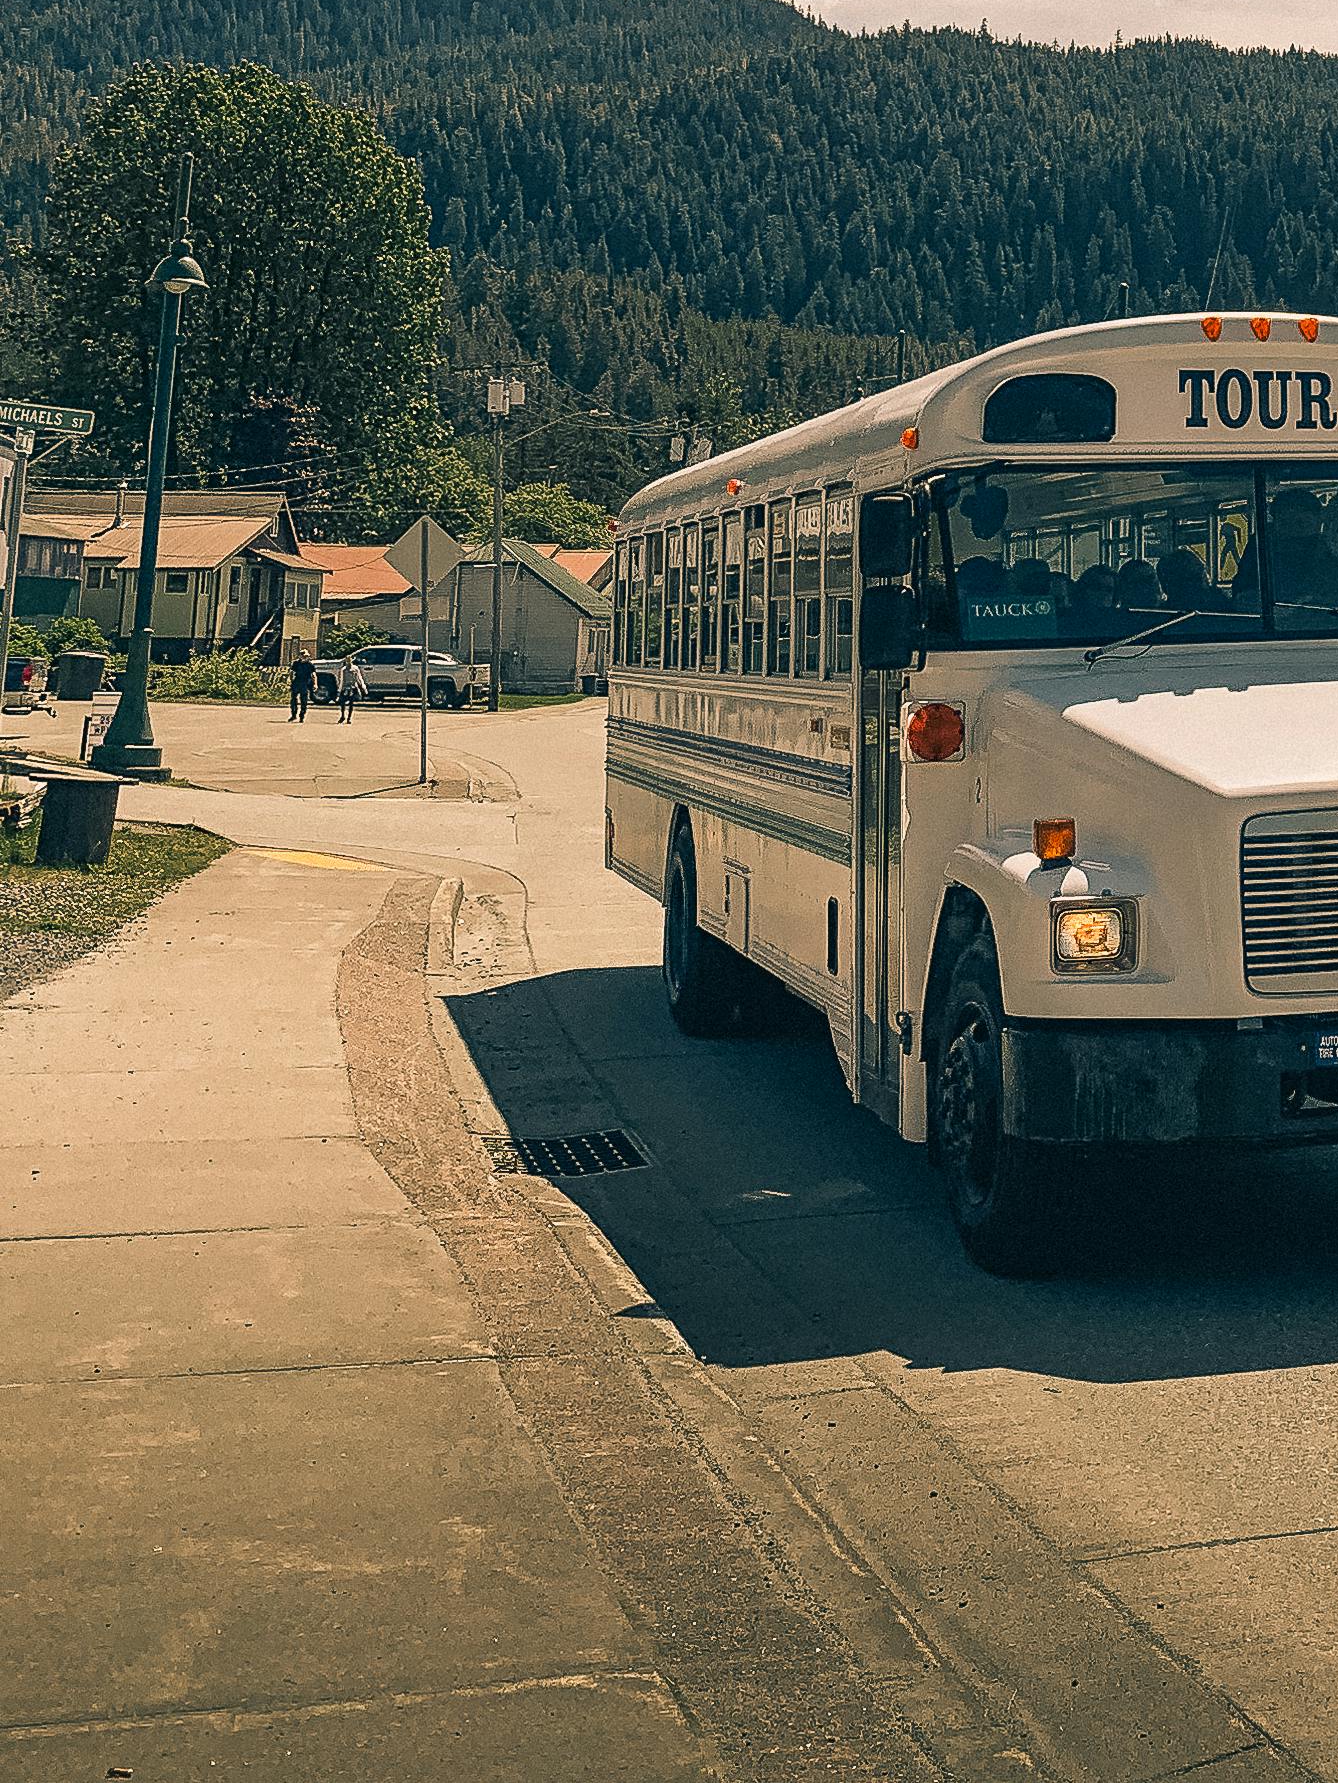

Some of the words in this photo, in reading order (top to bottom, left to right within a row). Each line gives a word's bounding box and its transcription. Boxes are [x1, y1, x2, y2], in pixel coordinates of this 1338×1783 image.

[1178, 368, 1338, 430] TOUR
[71, 417, 85, 429] ST
[971, 603, 1033, 617] TAUCK
